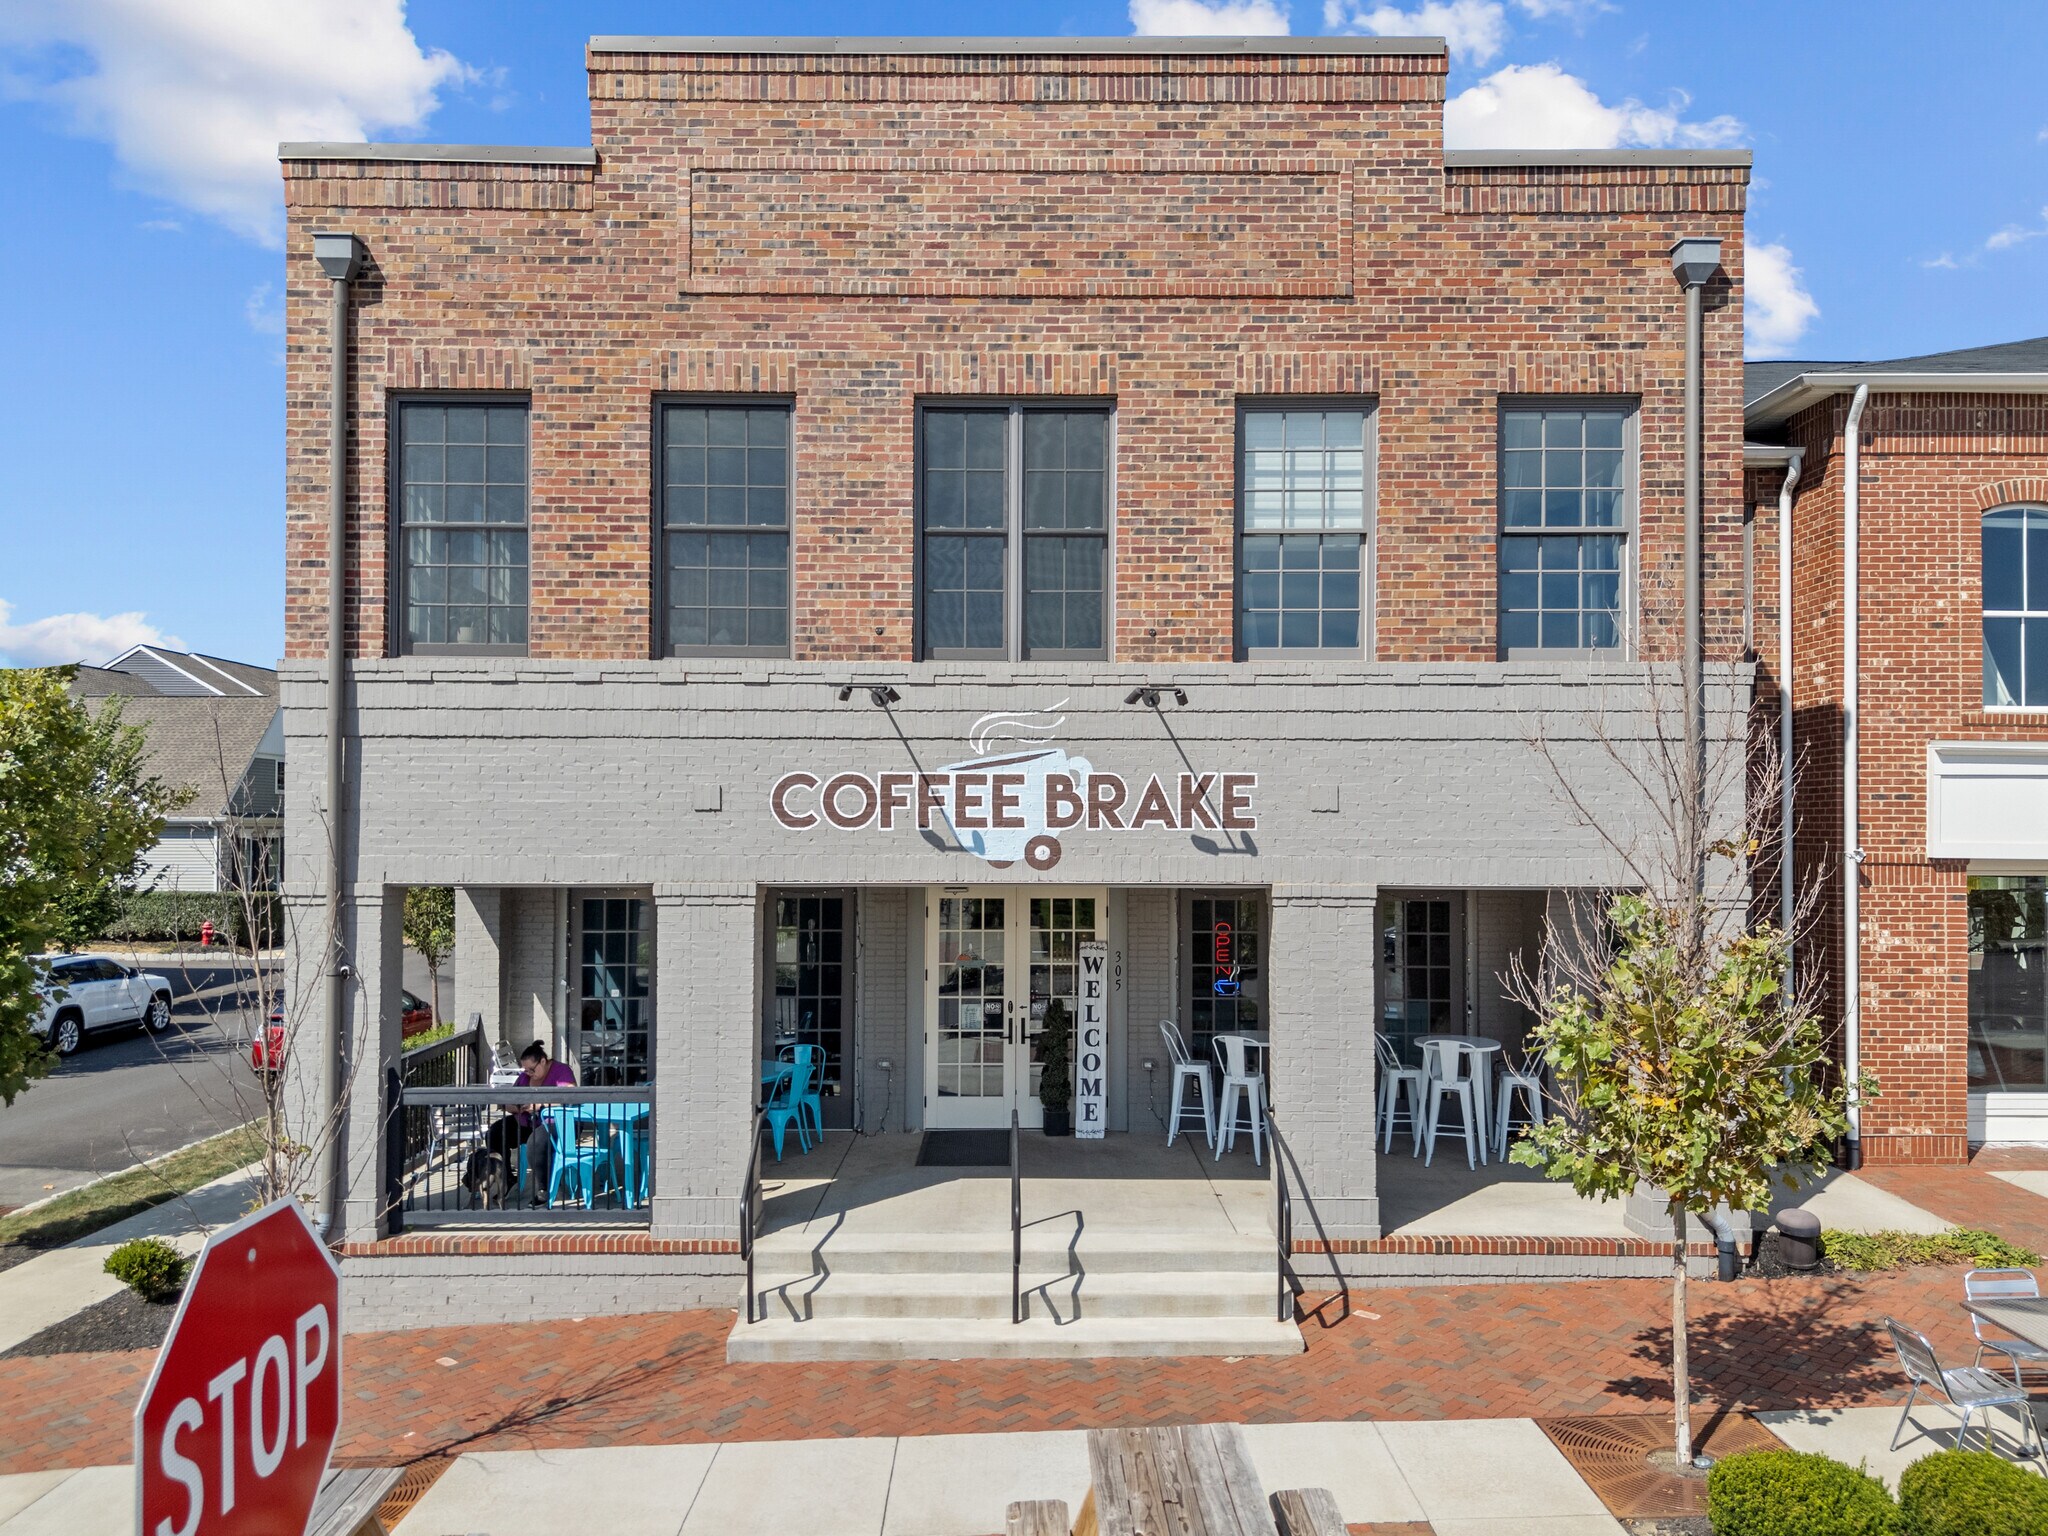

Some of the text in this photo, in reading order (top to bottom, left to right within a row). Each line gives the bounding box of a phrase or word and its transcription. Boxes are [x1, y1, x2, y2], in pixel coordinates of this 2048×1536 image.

[770, 771, 1258, 832] COFFEE BRAKE
[1215, 922, 1231, 975] OPEN
[1079, 955, 1104, 1122] WELCOME
[155, 1303, 329, 1536] STOP
